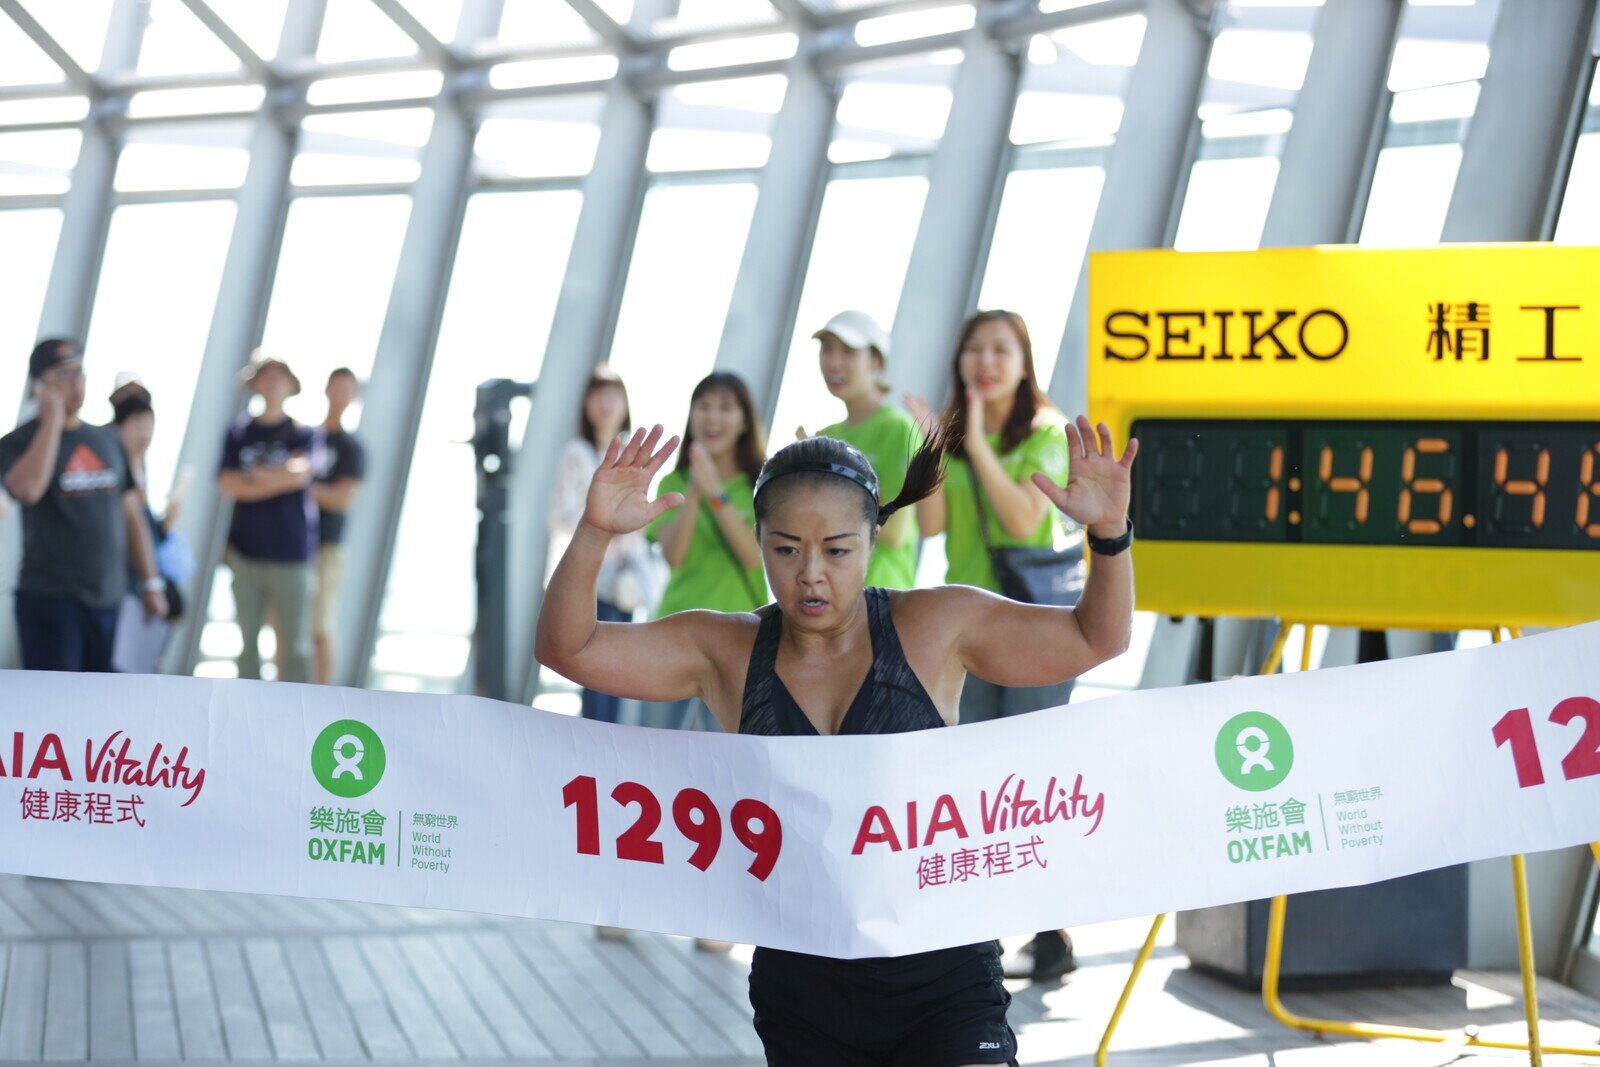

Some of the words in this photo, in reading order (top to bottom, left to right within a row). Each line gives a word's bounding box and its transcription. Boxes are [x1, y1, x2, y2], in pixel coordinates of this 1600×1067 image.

[1104, 308, 1350, 362] SEIKO
[1426, 301, 1583, 363] 精工
[0, 731, 72, 781] IA
[85, 730, 206, 808] Vitality
[19, 787, 146, 828] 健康程式
[308, 805, 388, 837] 樂施會
[850, 792, 969, 856] AIA
[980, 773, 1105, 838] Vitality
[1224, 797, 1308, 834] 樂施會
[1336, 809, 1368, 821] World
[412, 831, 441, 844] World
[562, 775, 783, 882] 1299
[1338, 820, 1384, 835] Without
[1341, 835, 1384, 849] Poverty
[306, 837, 387, 866] OXFAM
[411, 844, 452, 858] Without
[916, 835, 1048, 890] 健康程式
[1227, 830, 1313, 865] OXFAM
[411, 857, 450, 874] Poverty
